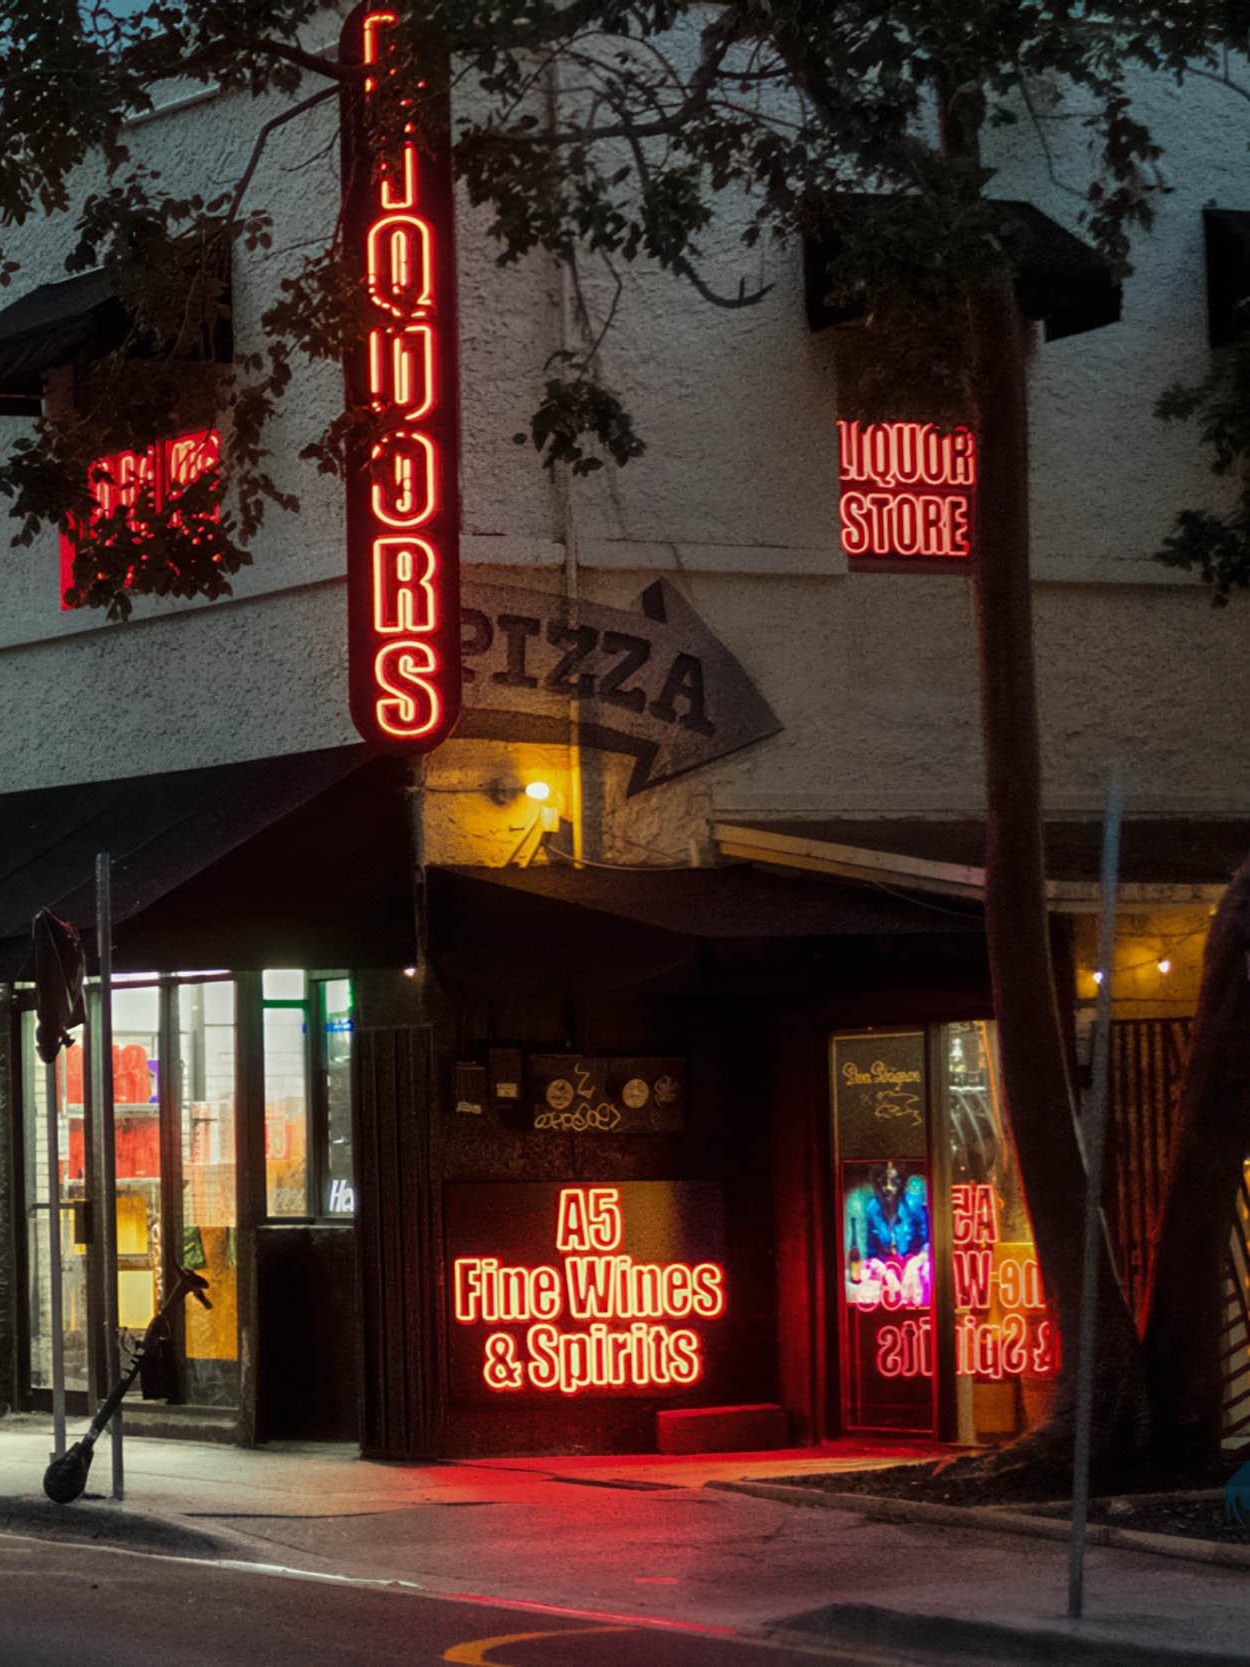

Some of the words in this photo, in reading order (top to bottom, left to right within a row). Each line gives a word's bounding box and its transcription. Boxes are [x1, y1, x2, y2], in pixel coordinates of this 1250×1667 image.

[836, 420, 976, 488] LIQUOR
[839, 490, 971, 557] STORE
[459, 607, 716, 738] PIZZA
[556, 1187, 622, 1251] A5
[453, 1257, 561, 1321] Fine
[565, 1255, 724, 1318] Wines
[483, 1332, 522, 1388] &
[526, 1323, 700, 1393] Spirits
